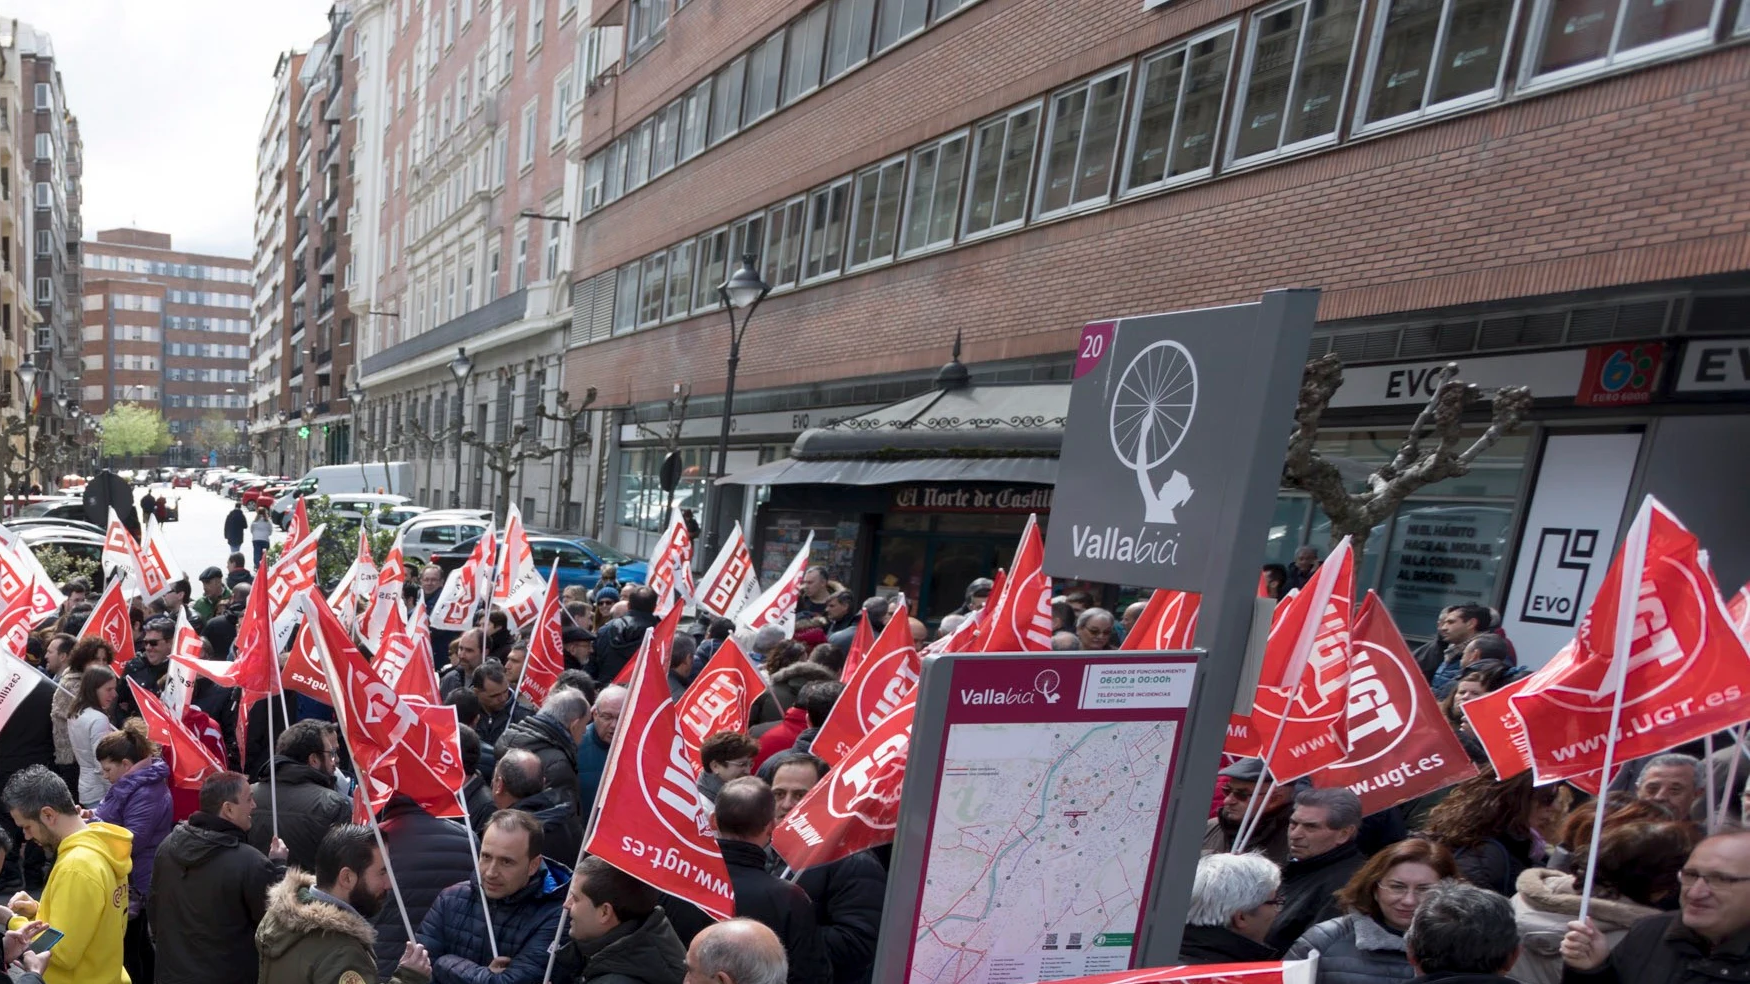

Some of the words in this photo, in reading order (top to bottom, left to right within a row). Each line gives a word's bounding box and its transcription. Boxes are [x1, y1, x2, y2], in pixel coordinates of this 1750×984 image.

[1082, 334, 1103, 358] 20
[1593, 393, 1619, 403] EURO
[1621, 391, 1650, 402] 6000
[793, 413, 809, 429] EVO
[898, 488, 917, 507] El
[924, 488, 970, 507] Norte
[974, 489, 993, 507] de
[1072, 524, 1179, 565] Vallabici
[1531, 595, 1570, 614] EVO
[1100, 676, 1127, 684] 06:00
[1137, 675, 1171, 683] 00:00h
[961, 684, 1035, 706] Vallabici
[682, 673, 743, 741] UGT
[1554, 684, 1742, 763] www.UGT.es
[1348, 752, 1446, 796] w.ugt.es
[621, 834, 736, 901] ww.ugt.es
